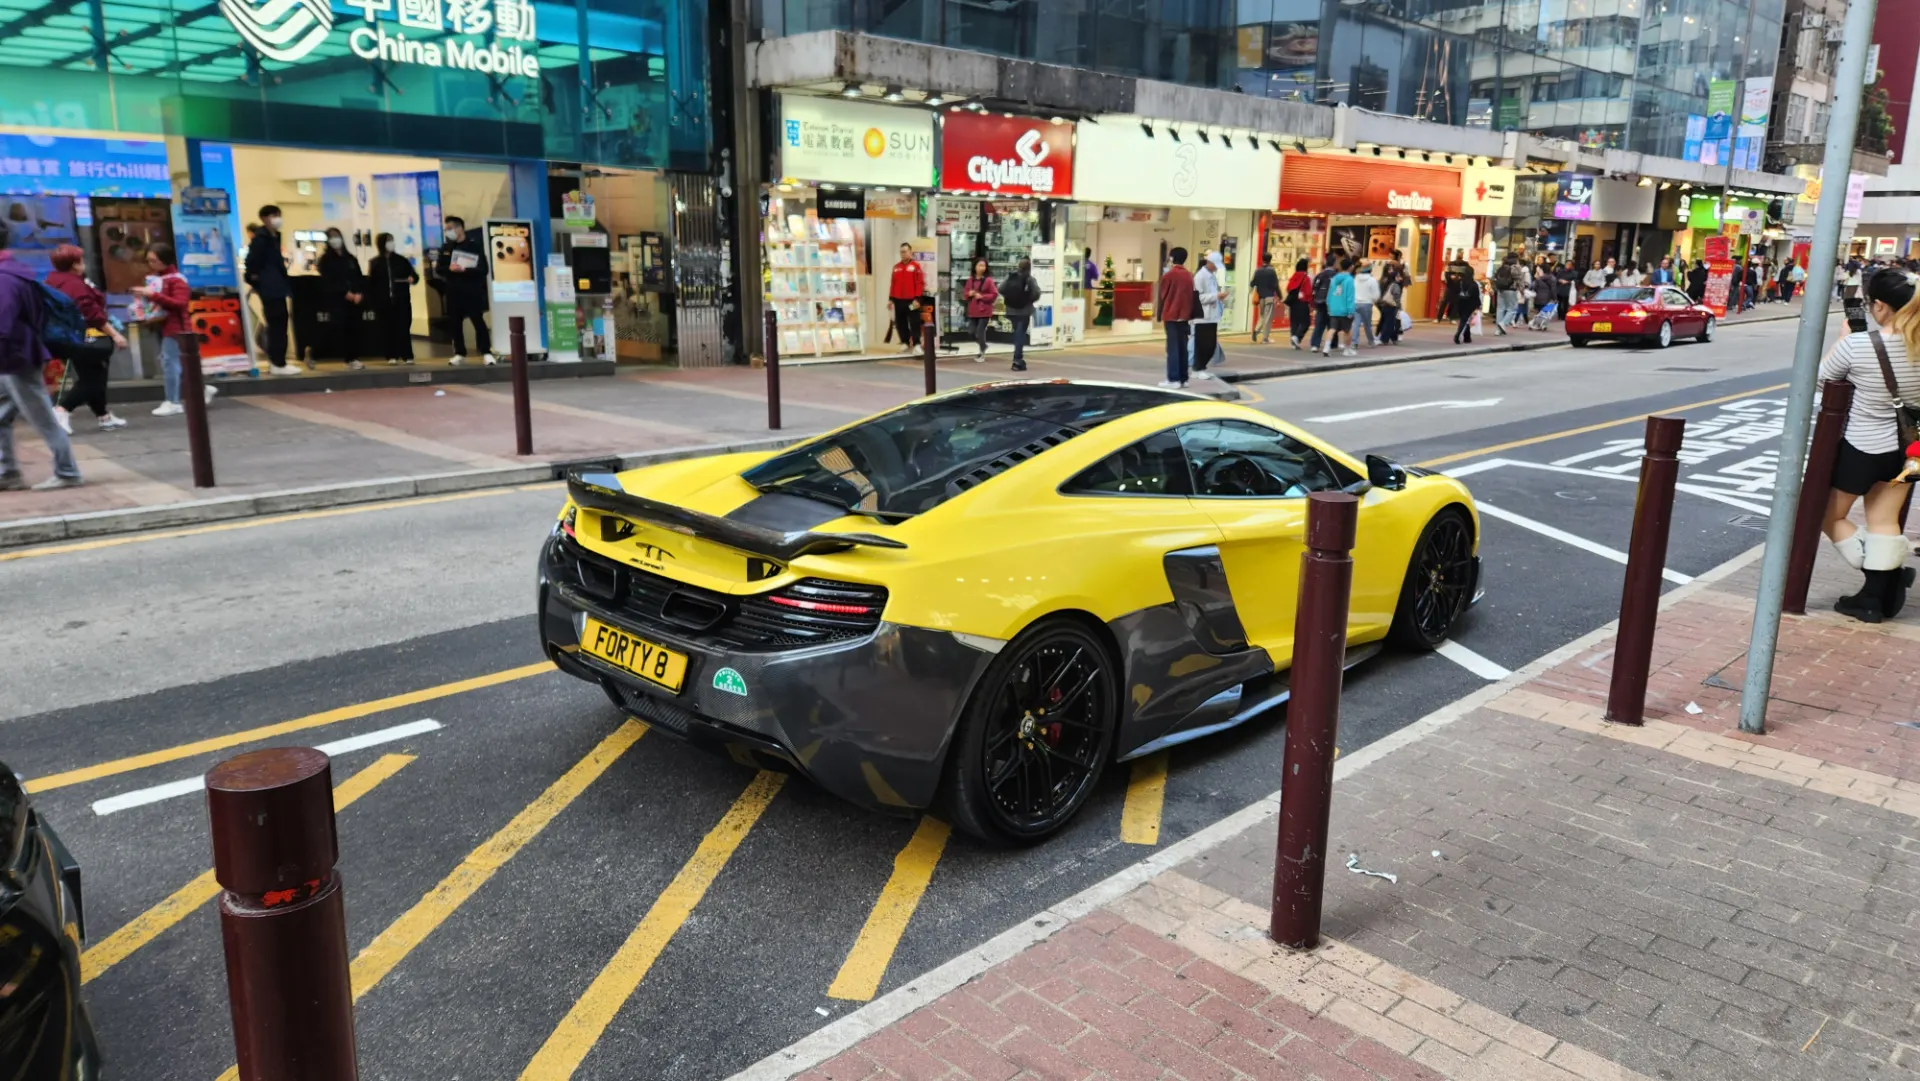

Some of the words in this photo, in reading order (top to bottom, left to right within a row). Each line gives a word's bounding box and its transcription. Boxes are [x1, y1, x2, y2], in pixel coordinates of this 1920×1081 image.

[349, 27, 442, 67] China
[446, 38, 540, 79] Mobile
[889, 132, 930, 152] SUN
[967, 155, 1032, 189] CityLink
[824, 200, 857, 210] SAMSUNG
[594, 625, 653, 672] FORTY
[654, 651, 669, 679] 8
[719, 682, 742, 694] SEATS
[726, 675, 733, 684] 2
